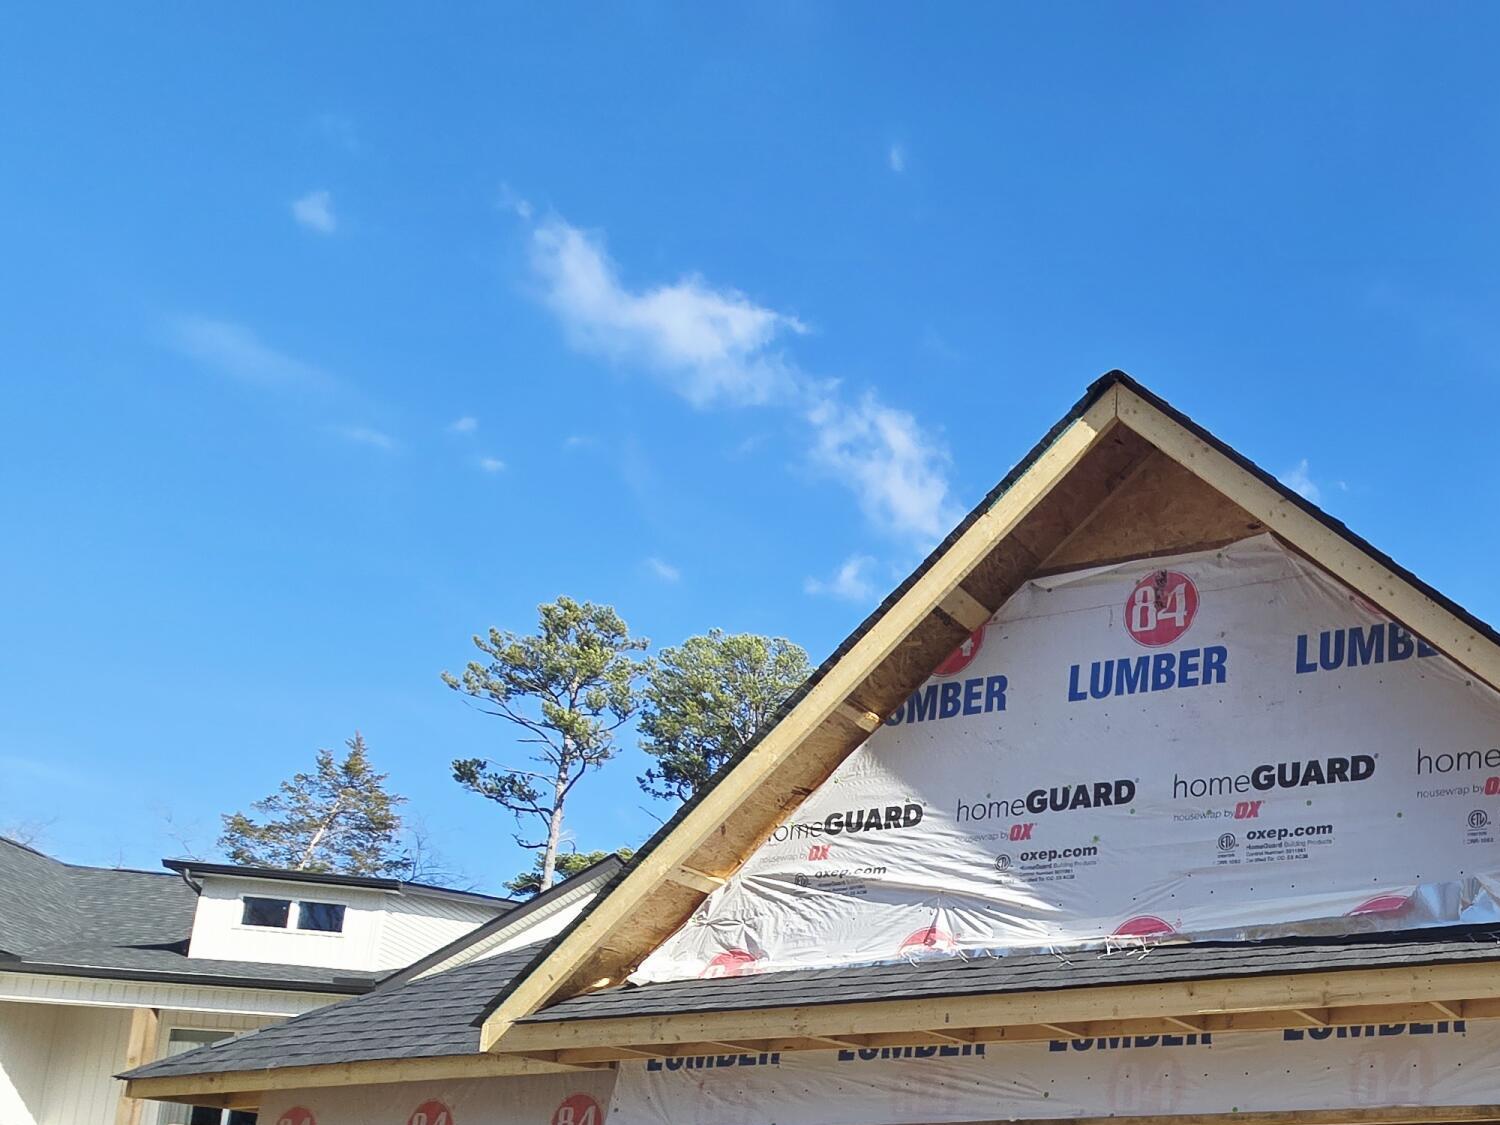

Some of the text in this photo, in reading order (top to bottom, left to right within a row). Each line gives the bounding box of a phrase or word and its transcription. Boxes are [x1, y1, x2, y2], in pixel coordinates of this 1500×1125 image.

[1132, 583, 1188, 632] 84
[1296, 623, 1440, 674] LUMB
[1068, 645, 1228, 702] LUMBER
[883, 674, 1008, 726] MBER
[1173, 754, 1376, 799] homeGUARD
[956, 780, 1136, 822] homeGUARD
[1234, 801, 1262, 819] OX
[768, 804, 924, 842] omeGUARD
[1010, 823, 1034, 841] OX
[1246, 824, 1333, 840] oxep.com
[1020, 846, 1098, 861] oxep.com
